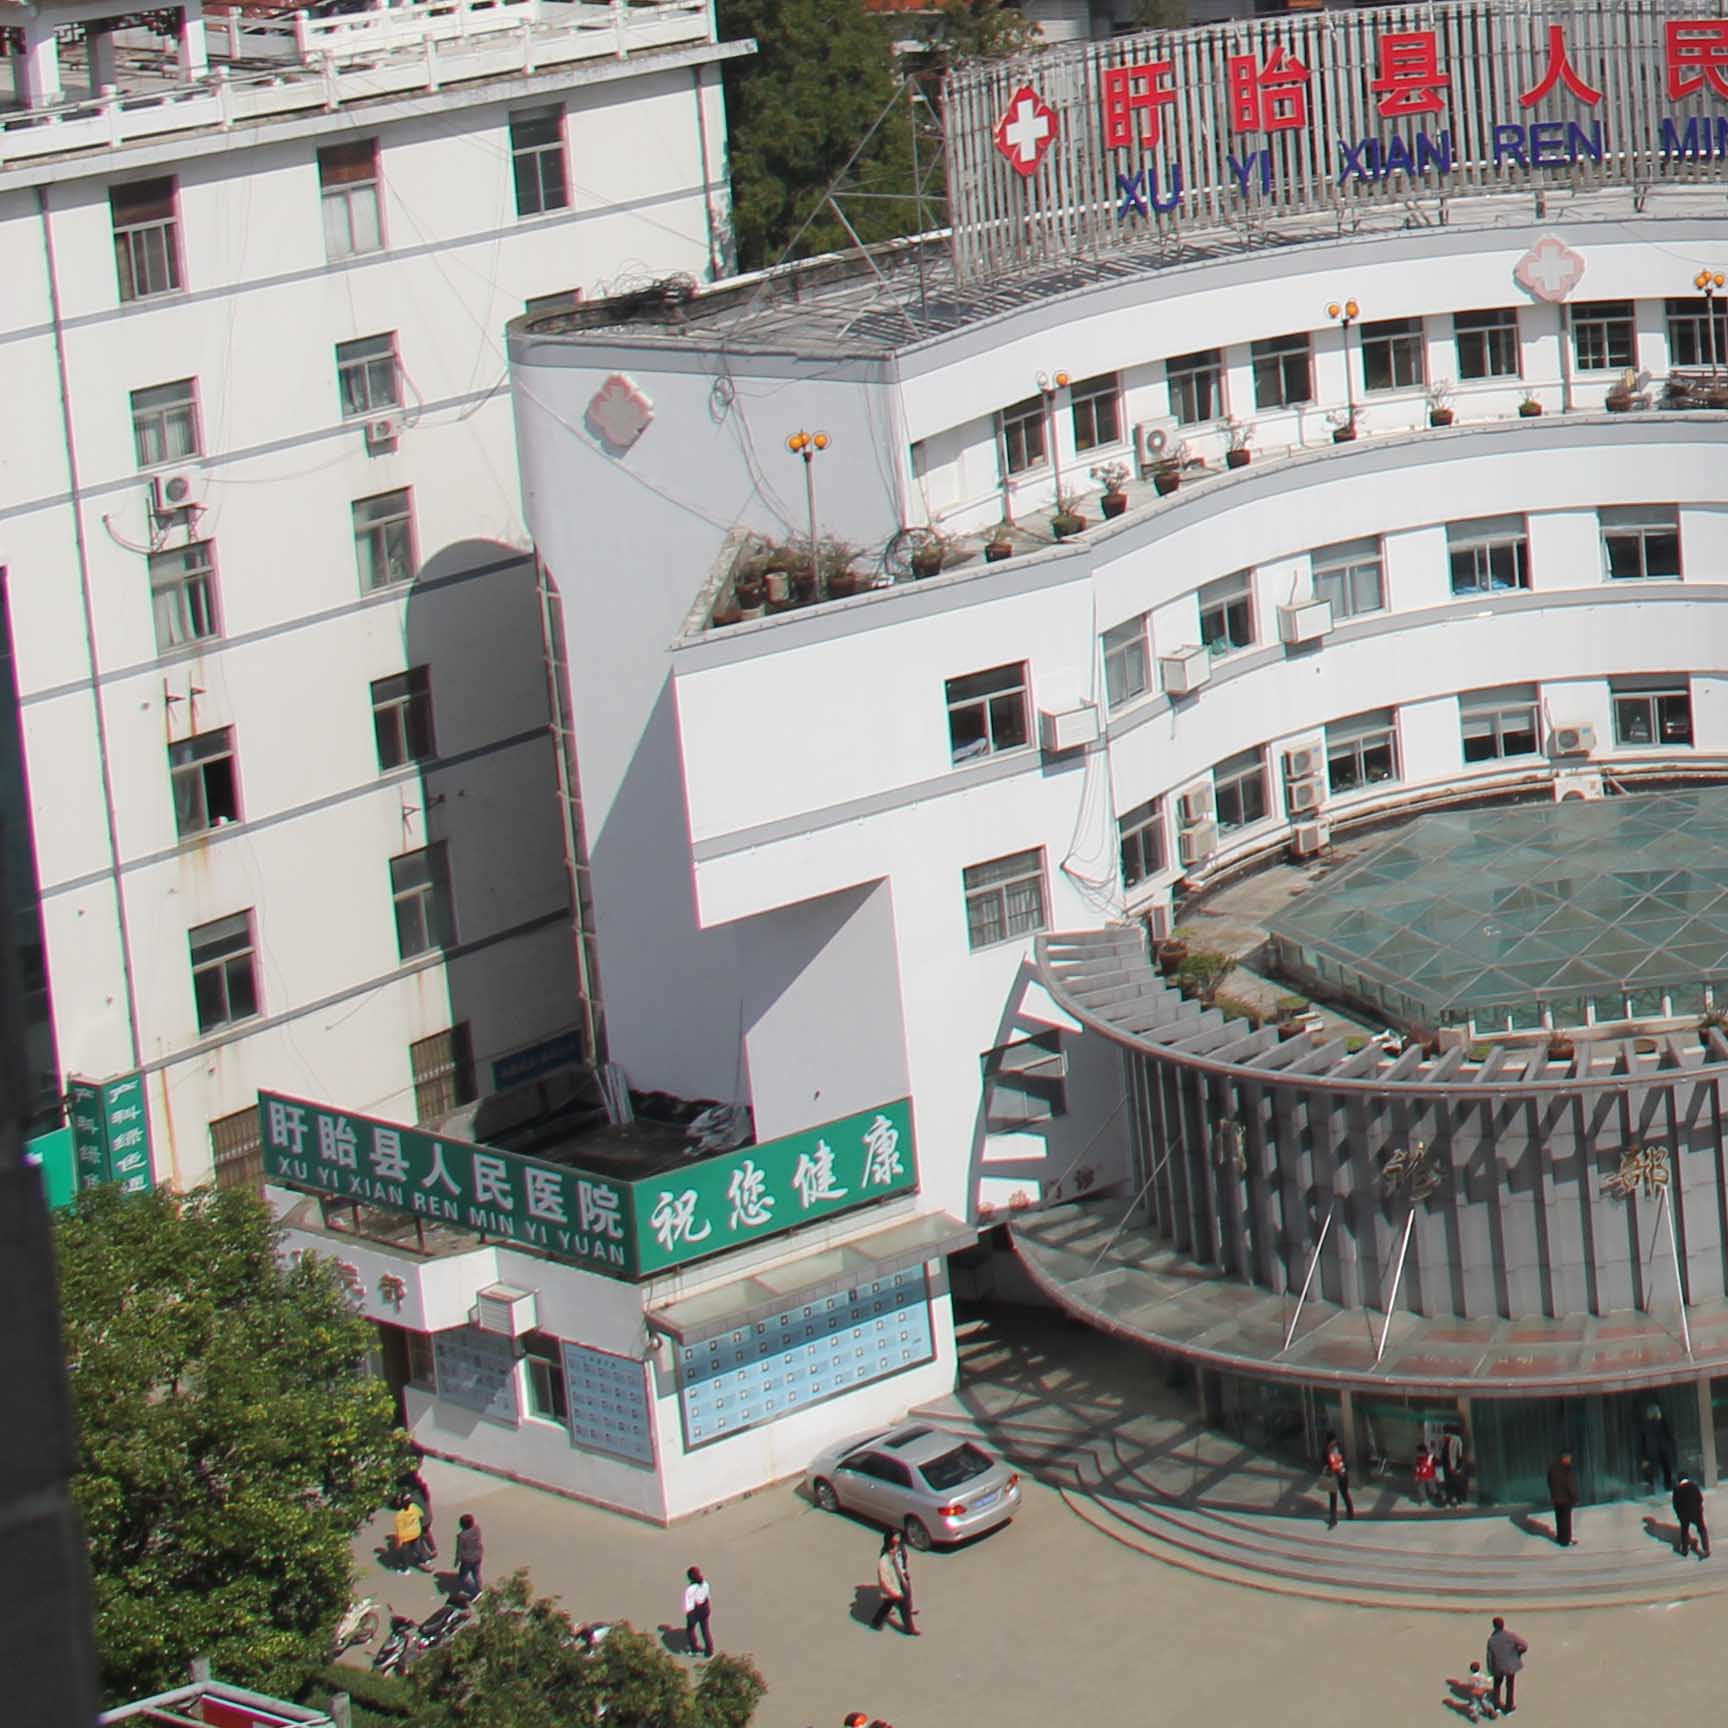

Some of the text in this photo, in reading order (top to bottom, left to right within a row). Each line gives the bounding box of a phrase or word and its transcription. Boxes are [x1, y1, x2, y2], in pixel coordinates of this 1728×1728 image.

[1117, 162, 1182, 220] XU
[1227, 150, 1272, 199] YI
[1337, 129, 1451, 185] XIAN
[1494, 120, 1601, 171] REN
[269, 1100, 624, 1240] 盱眙县人民医院
[277, 1155, 625, 1266] XU YI XIAN REN MIN YI YUAN
[650, 1114, 904, 1252] 祝您健康
